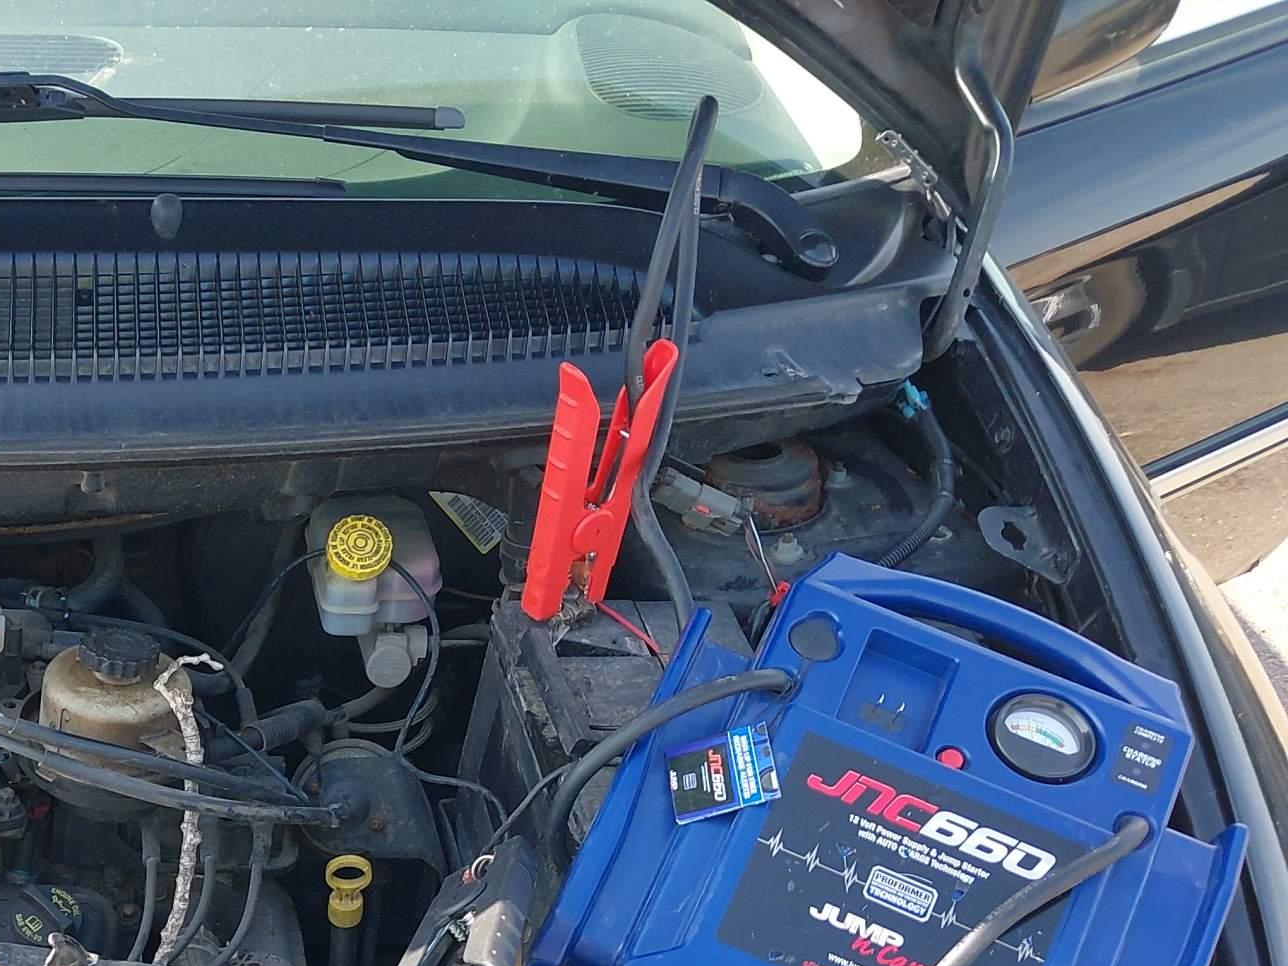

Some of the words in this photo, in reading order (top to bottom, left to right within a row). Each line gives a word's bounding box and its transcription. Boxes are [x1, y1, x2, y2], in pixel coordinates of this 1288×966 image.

[858, 829, 877, 843] with
[876, 836, 899, 852] AUTO
[930, 858, 975, 885] Technology
[876, 825, 902, 842] Power
[902, 836, 930, 855] Supply
[937, 852, 961, 868] Jump
[961, 861, 991, 879] Starter
[869, 885, 927, 916] TECHNOLOGY
[875, 872, 931, 902] PROFORMER
[15, 913, 25, 928] SAE
[809, 902, 905, 948] JUMP
